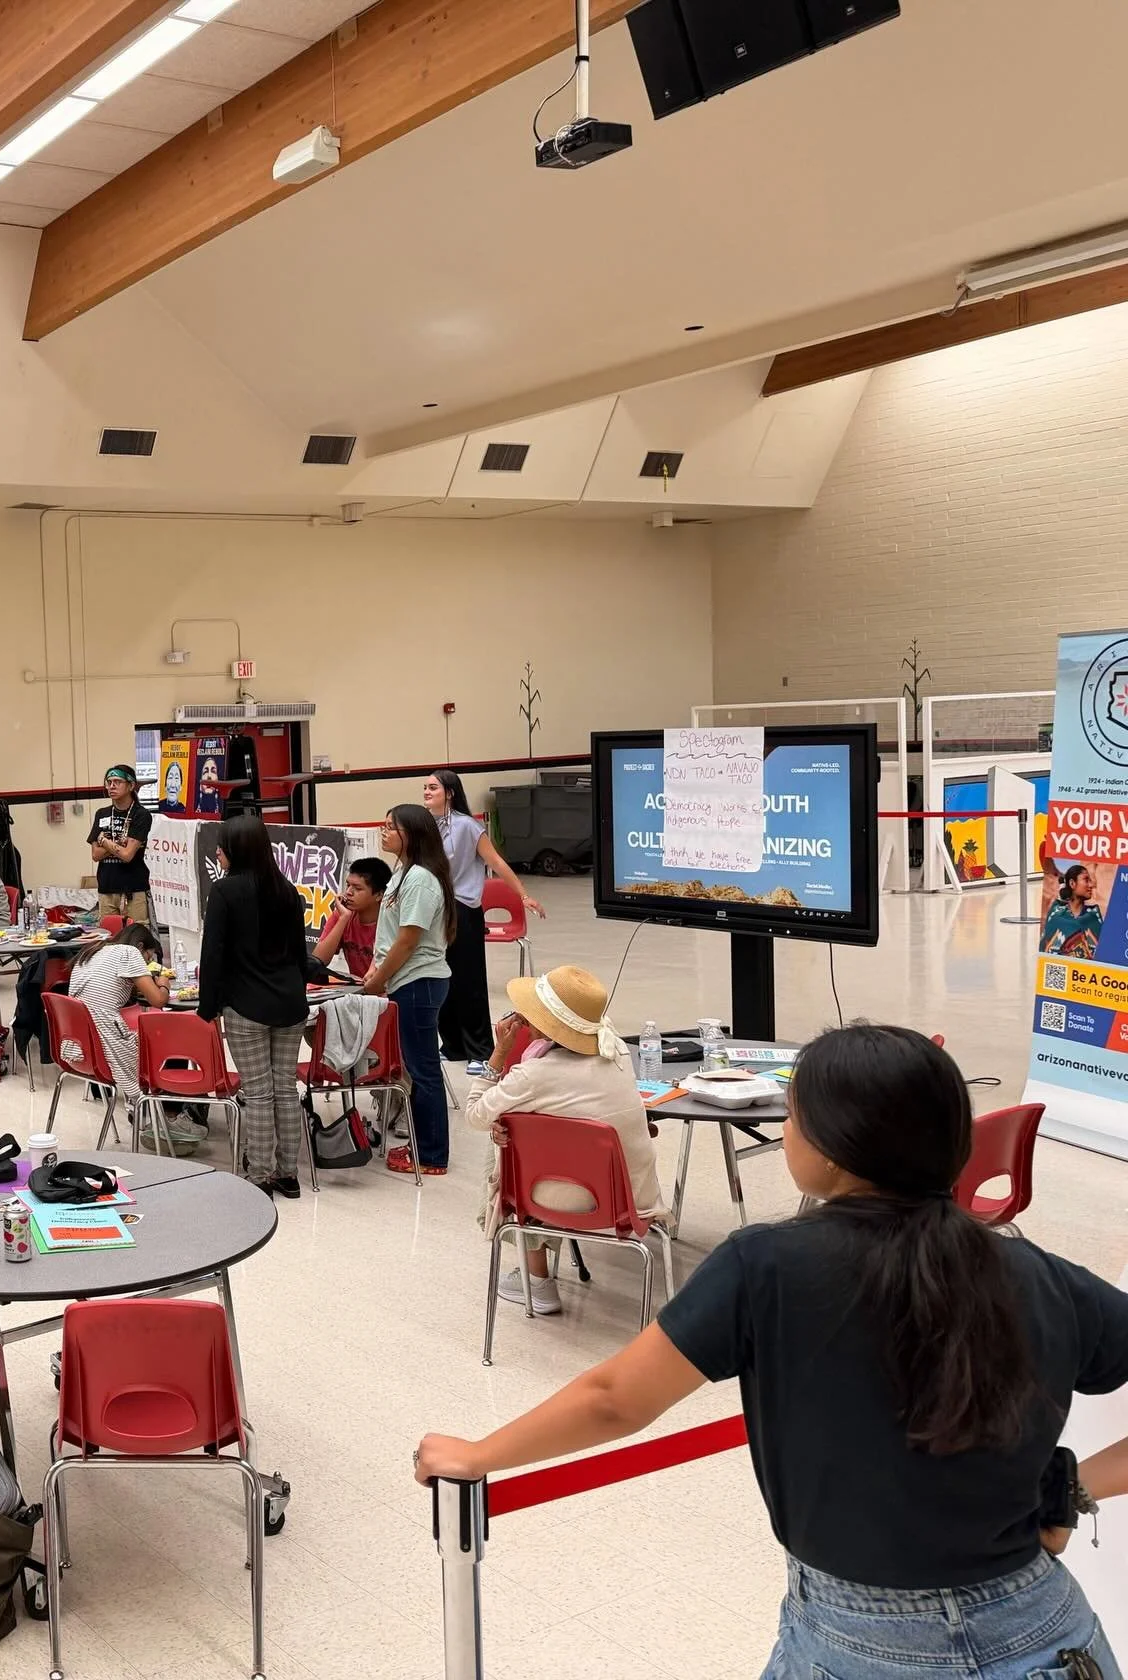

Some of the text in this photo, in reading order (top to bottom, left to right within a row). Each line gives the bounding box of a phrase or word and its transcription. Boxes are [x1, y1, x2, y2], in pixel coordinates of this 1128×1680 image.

[237, 662, 253, 676] EXIT
[1084, 788, 1108, 796] granted
[763, 795, 809, 814] OUTH
[1053, 806, 1112, 833] YOUR
[146, 838, 189, 855] ZONA
[627, 831, 832, 858] CULT NIZING
[1050, 831, 1111, 858] YOUR
[271, 841, 340, 894] WER
[1071, 969, 1087, 983] Be
[1088, 973, 1098, 985] A
[1071, 983, 1092, 996] Scan
[1094, 988, 1103, 997] to
[1068, 1012, 1095, 1024] Scan To
[1068, 1020, 1094, 1032] Donate
[1037, 1052, 1128, 1082] arizonanativevo
